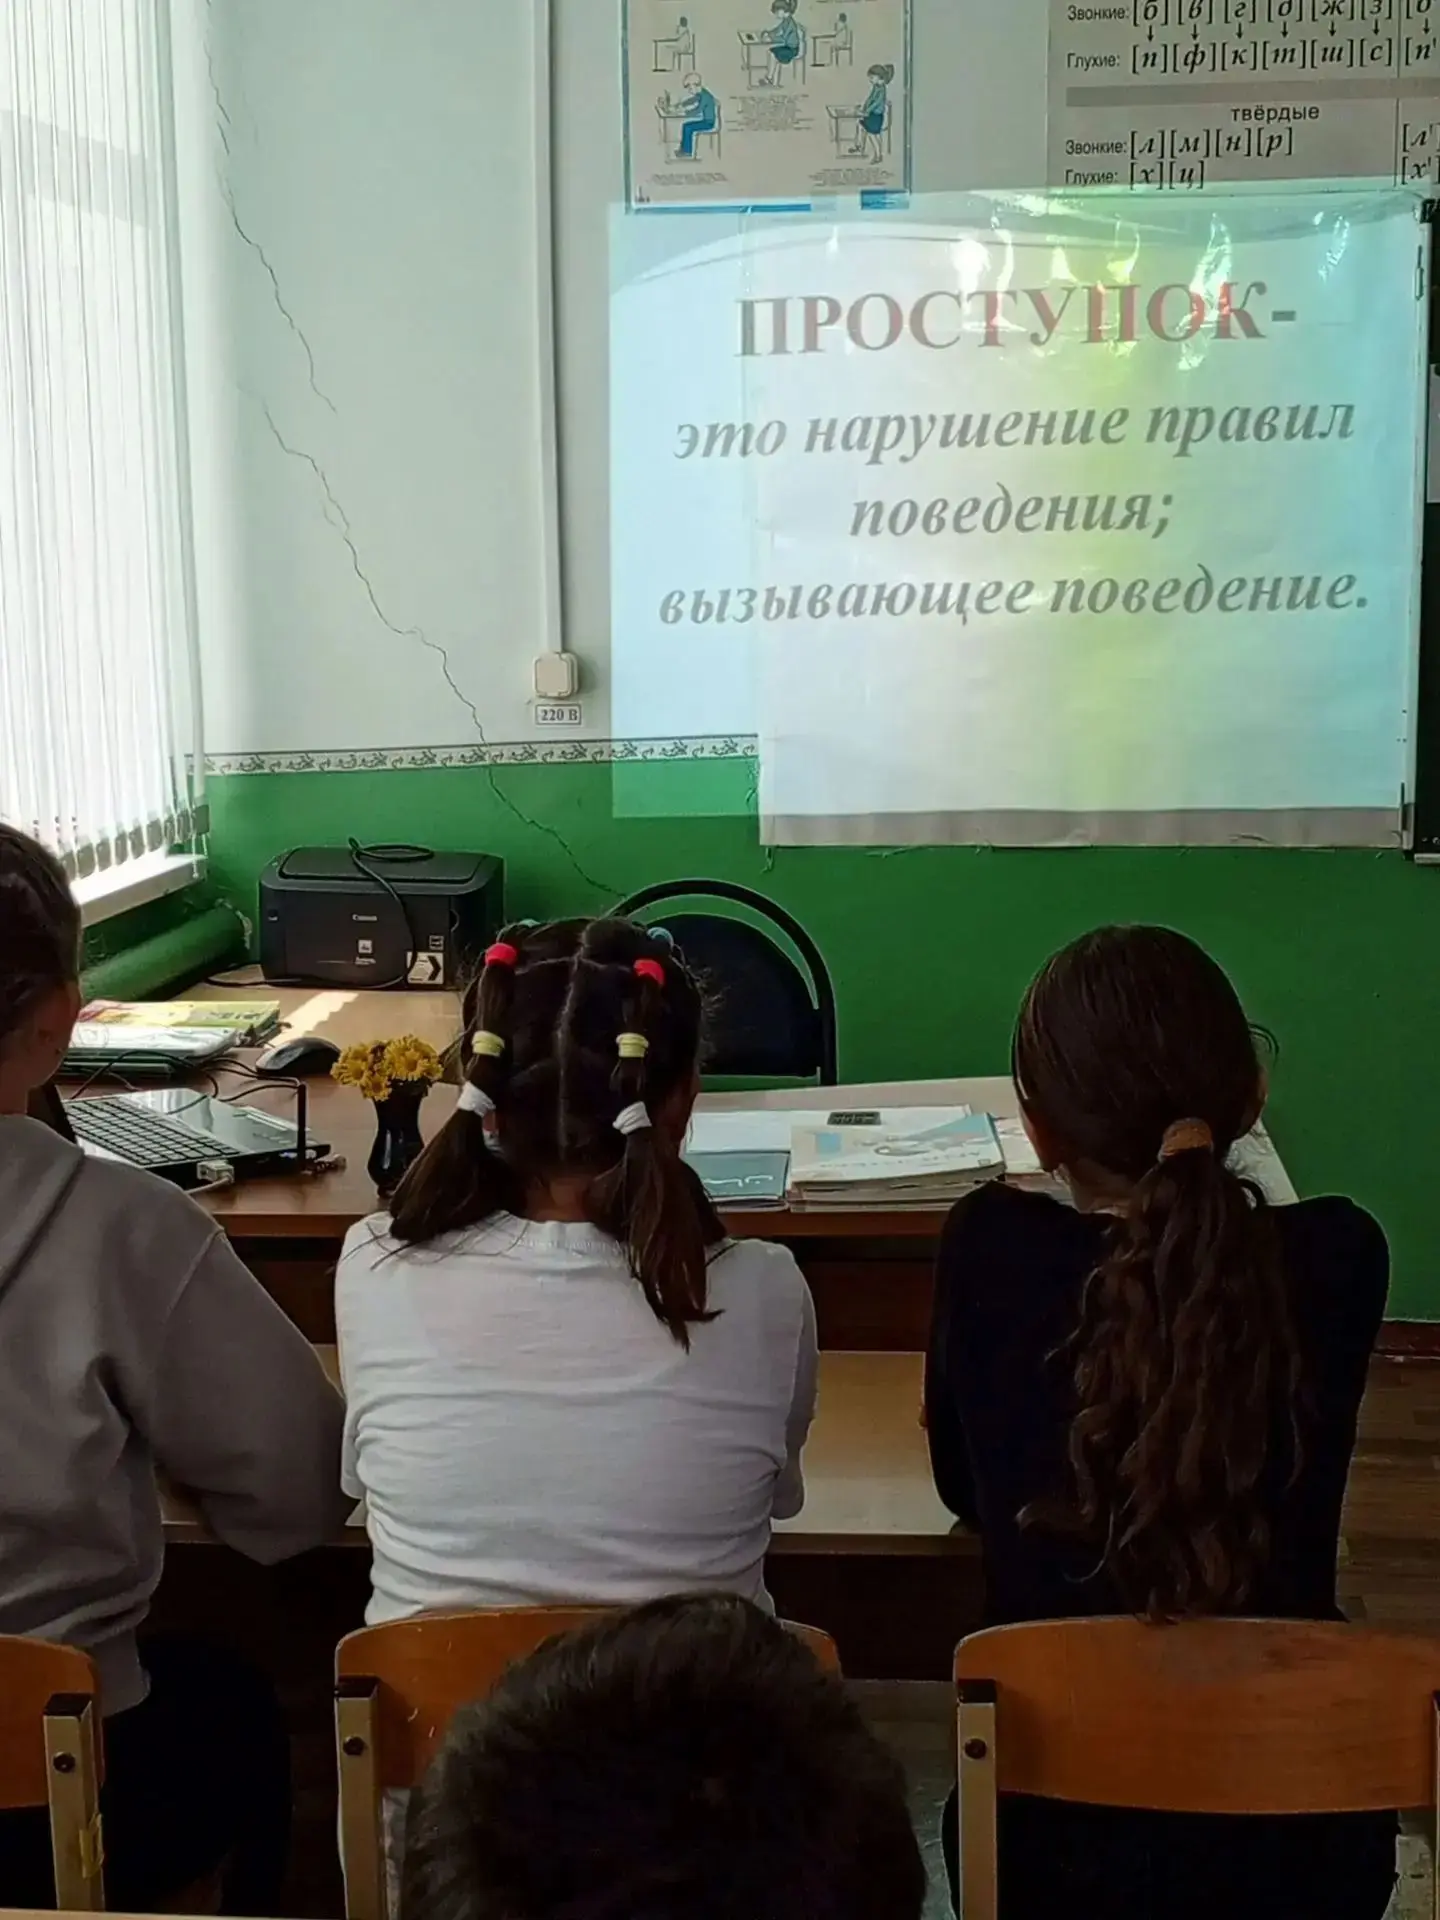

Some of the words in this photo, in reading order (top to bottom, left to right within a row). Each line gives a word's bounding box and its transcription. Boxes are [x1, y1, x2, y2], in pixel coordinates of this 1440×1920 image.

[1067, 4, 1130, 21] Звонкие:
[1066, 52, 1121, 72] Глухие:
[1230, 105, 1320, 124] твёрдые
[1065, 139, 1128, 156] Звонкие:
[1064, 168, 1119, 186] Глухие:
[734, 280, 1297, 358] ПРОСТУПОК-
[672, 418, 788, 460] это
[803, 404, 1131, 466] нарушение
[1145, 402, 1356, 459] правил
[848, 481, 1174, 540] поведения;
[658, 578, 1036, 628] вызывающее
[1049, 562, 1369, 615] поведение.
[541, 708, 565, 721] 220
